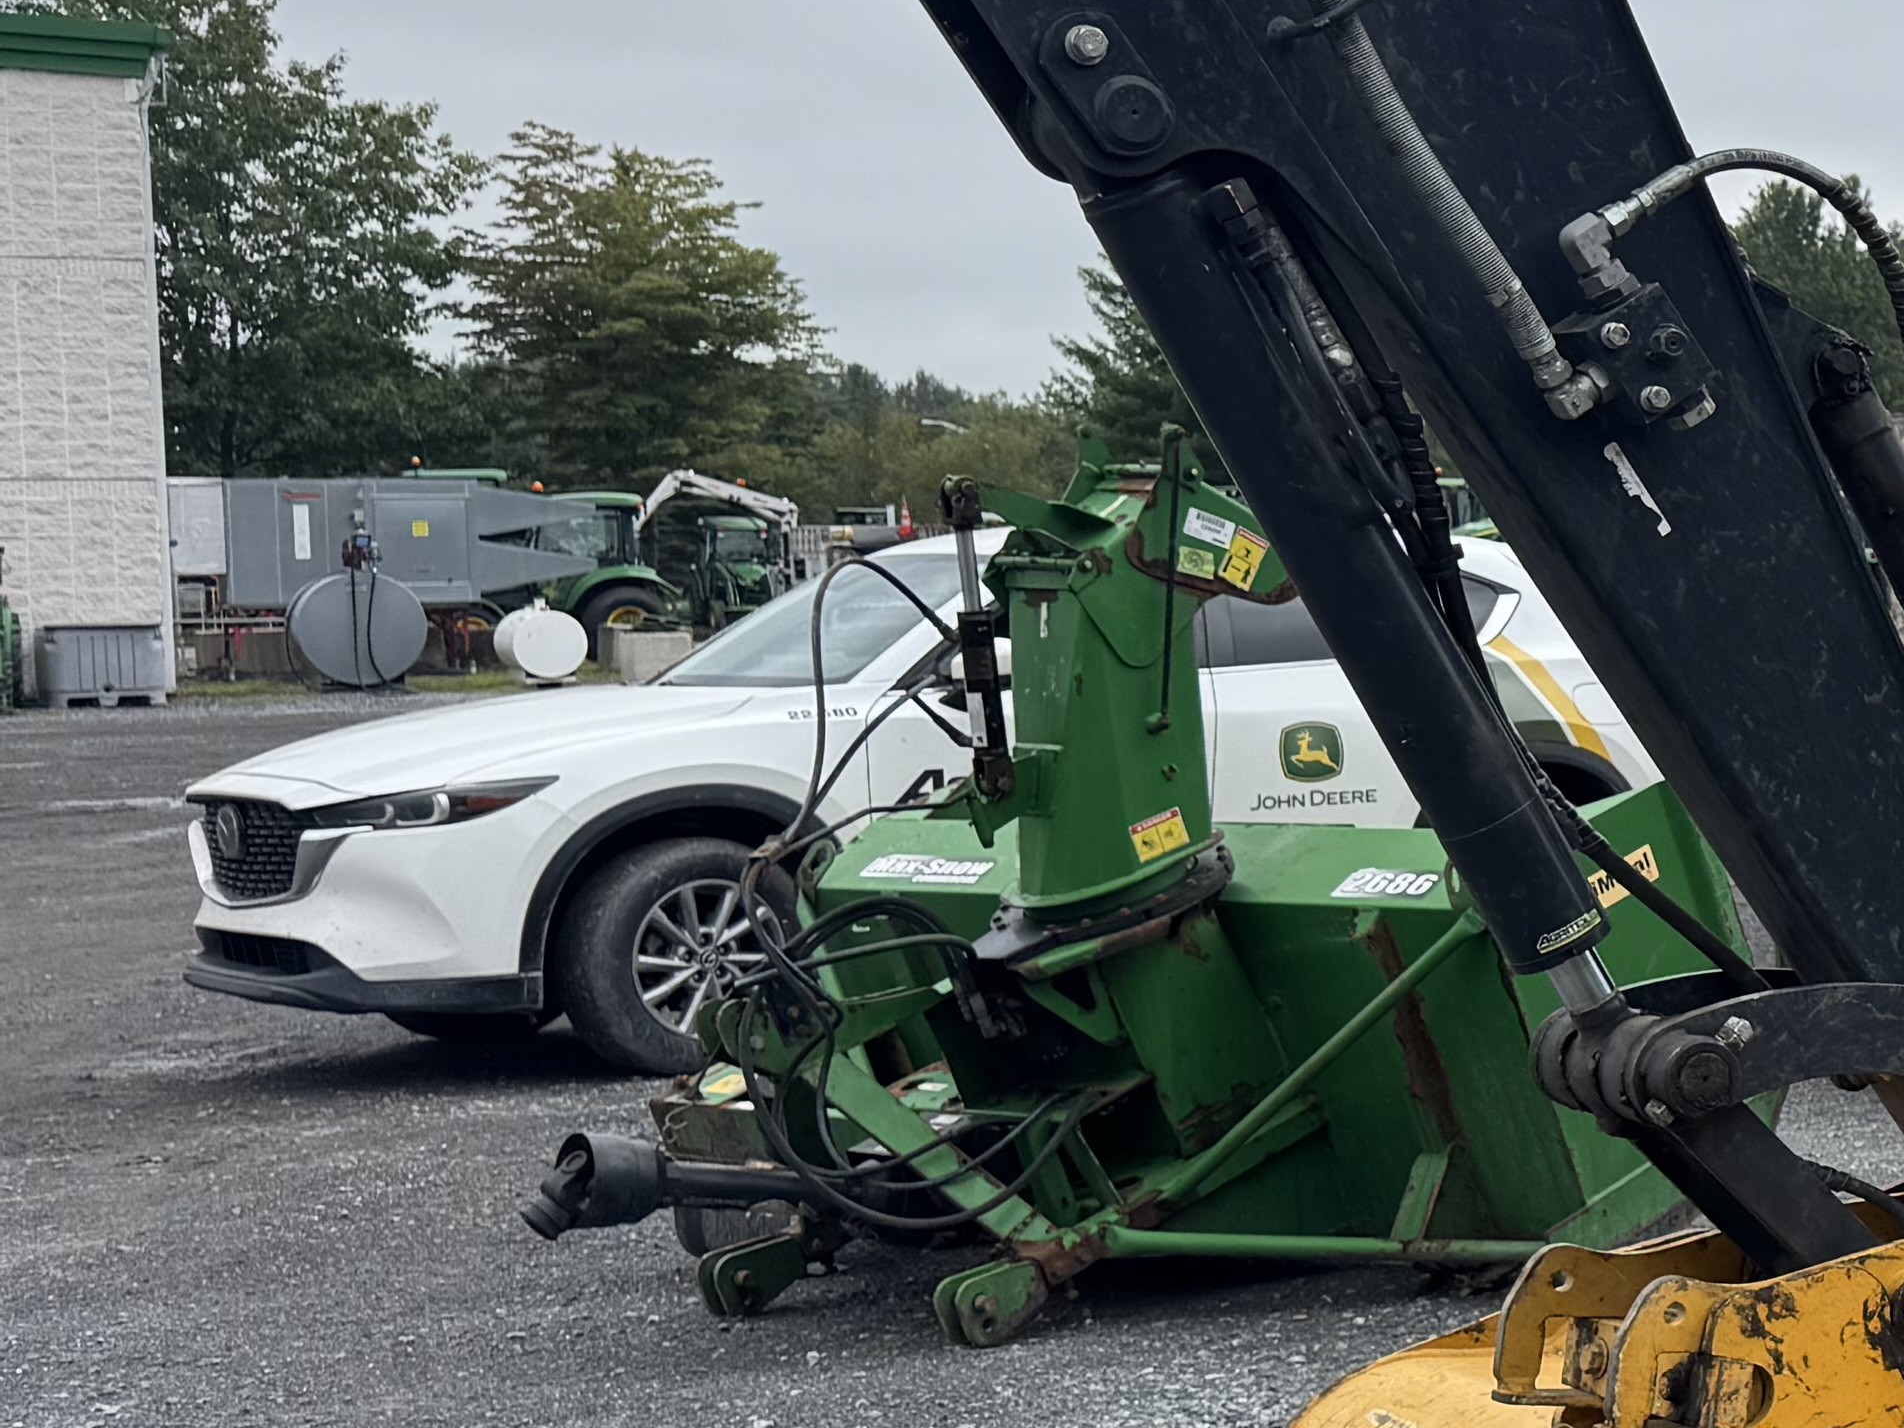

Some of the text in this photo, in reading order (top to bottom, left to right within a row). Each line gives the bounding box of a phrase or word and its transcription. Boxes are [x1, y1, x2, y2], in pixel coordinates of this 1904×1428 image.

[1250, 788, 1378, 811] JOHN DEERE
[1339, 871, 1440, 896] 2686
